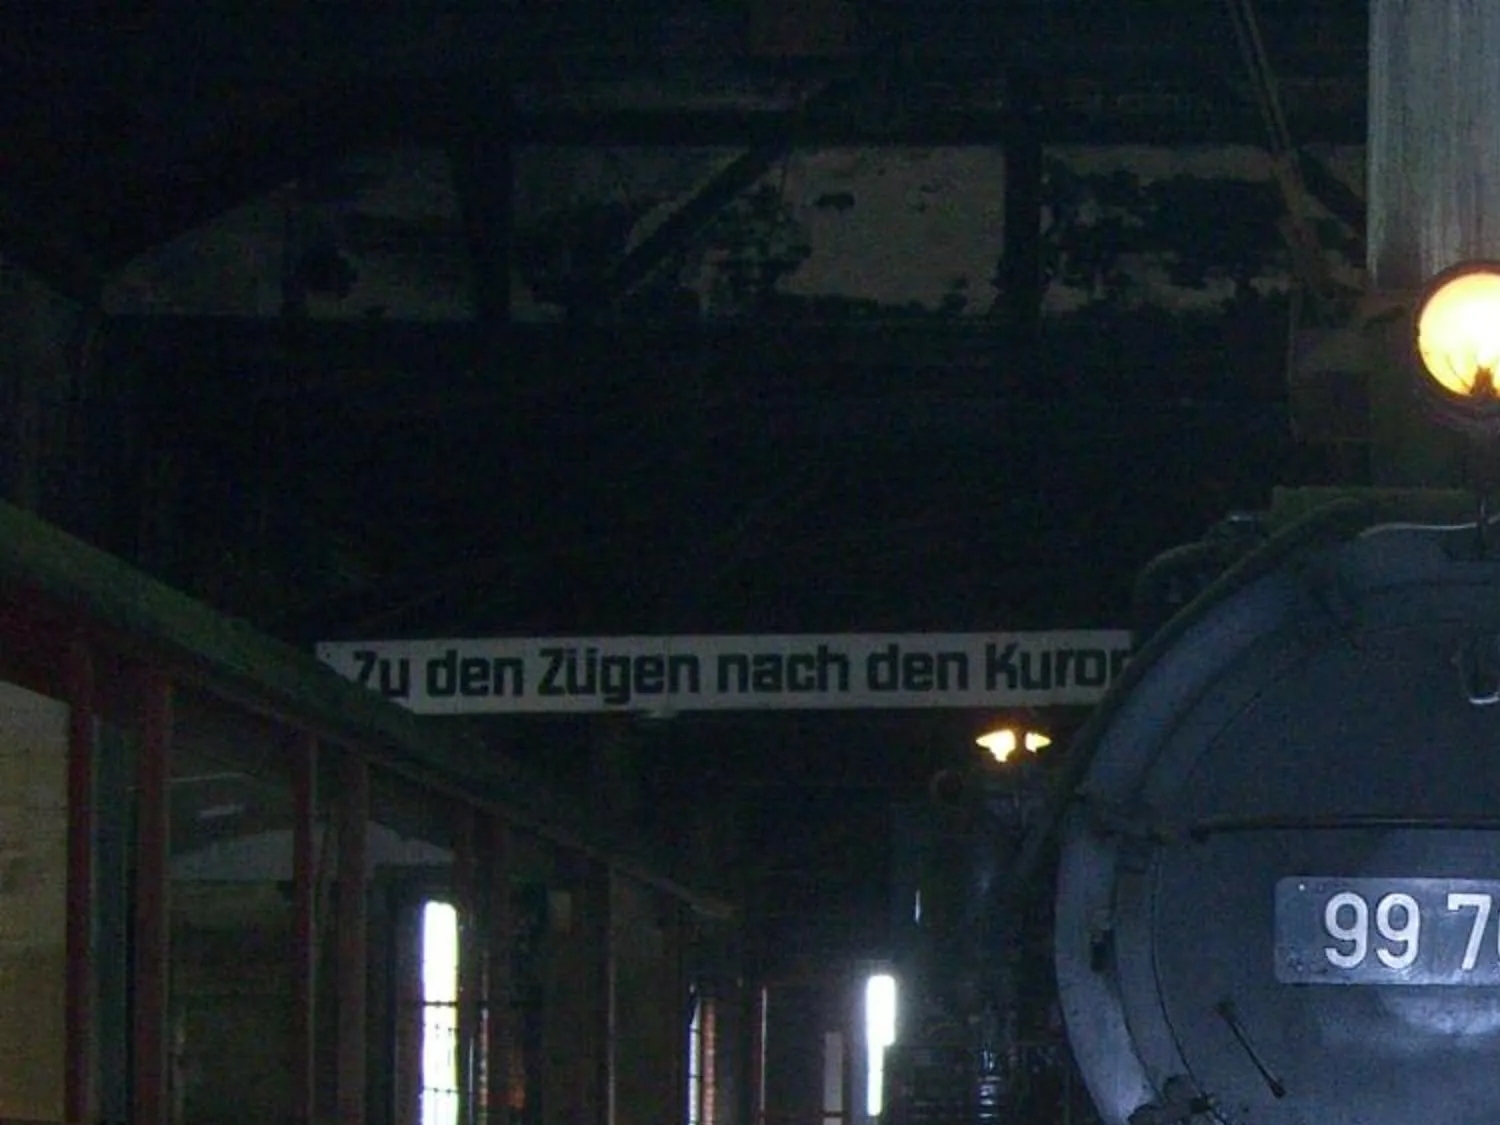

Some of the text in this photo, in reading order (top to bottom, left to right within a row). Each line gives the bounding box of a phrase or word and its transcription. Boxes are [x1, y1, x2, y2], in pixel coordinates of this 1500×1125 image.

[353, 650, 409, 697] Zu
[427, 650, 523, 695] den
[538, 648, 699, 704] Zügen
[717, 645, 849, 692] nach
[868, 644, 967, 691] den
[1324, 891, 1421, 969] 99
